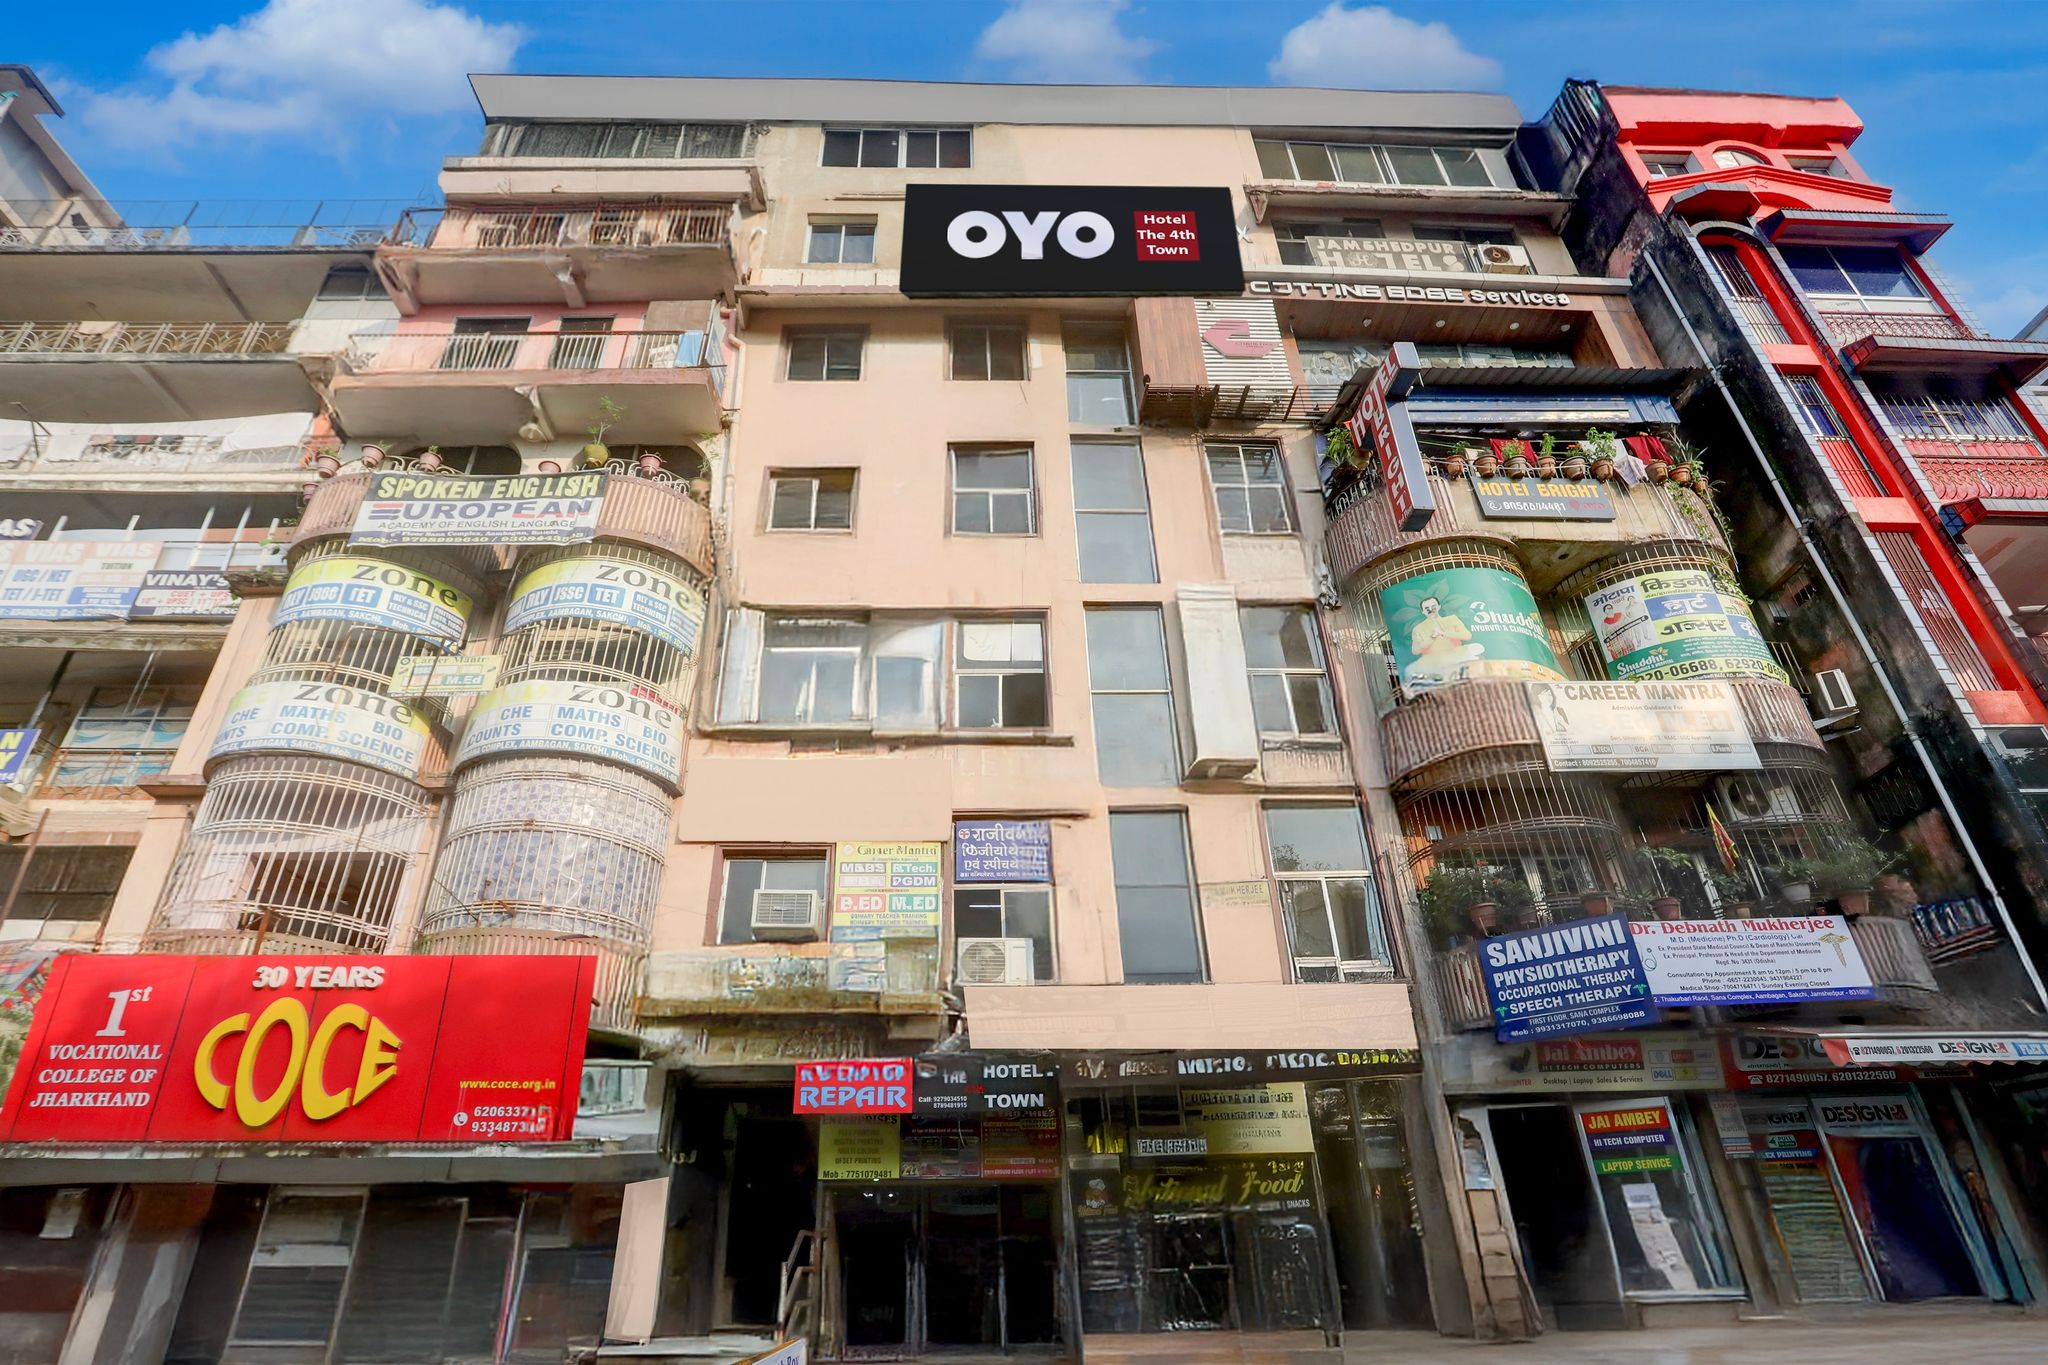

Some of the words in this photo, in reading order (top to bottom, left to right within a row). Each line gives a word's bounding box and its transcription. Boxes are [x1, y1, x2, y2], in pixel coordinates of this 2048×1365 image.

[1144, 214, 1187, 225] Hotel
[947, 210, 1115, 260] OYO
[1138, 230, 1167, 240] The
[1169, 229, 1196, 240] 4th
[1147, 245, 1189, 255] Town
[1470, 289, 1571, 306] Services
[1352, 360, 1398, 448] HOTEL
[377, 476, 486, 499] SPOKEN
[491, 474, 601, 499] ENGLISH
[1536, 483, 1600, 498] BRIGHT
[368, 499, 594, 521] EUROPEAN
[378, 521, 436, 530] ACADEMY
[438, 521, 455, 529] OF
[457, 521, 509, 529] ENGLISH
[146, 573, 230, 586] VINAY's
[352, 564, 459, 607] zone
[596, 564, 691, 610] zone
[526, 590, 549, 609] RLY
[554, 586, 585, 602] JSSC
[594, 586, 620, 604] TET
[348, 610, 384, 624] SAKCHI,
[548, 608, 594, 618] AAMBAGAN,
[596, 610, 628, 625] SAKCHI,
[446, 675, 483, 685] M.Ed
[1564, 683, 1641, 701] CAREER
[1643, 683, 1726, 701] MANTRA
[294, 683, 413, 725] zone
[568, 683, 673, 730] zone
[231, 707, 261, 724] CHE
[279, 704, 347, 723] MATHS
[372, 720, 403, 741] BIO
[500, 705, 534, 721] CHE
[557, 706, 622, 727] MATHS
[643, 725, 667, 745] BIO
[271, 721, 329, 738] COMP.
[336, 731, 415, 765] SCIENCE
[520, 739, 570, 749] AAMBAGAN,
[574, 741, 609, 754] SAKCHI,
[550, 723, 608, 742] COMP.
[614, 733, 677, 768] SCIENCE
[840, 896, 883, 910] B.ED
[892, 896, 936, 910] M.ED
[1628, 921, 1656, 935] Dr.
[1661, 919, 1738, 934] Debnath
[1742, 917, 1835, 934] Mukherjee
[1486, 919, 1627, 968] SANJIVINI
[1688, 935, 1726, 943] (Medicine)
[1745, 933, 1790, 942] (Cardiology)
[1760, 949, 1789, 957] Department
[1492, 949, 1631, 988] PHYSIOTHERAPY
[1714, 970, 1752, 978] Appointment
[252, 966, 289, 989] 30
[294, 966, 385, 989] YEARS
[1498, 977, 1582, 1002] OCCUPATIONAL
[1582, 967, 1636, 988] THERAPY
[1784, 981, 1808, 989] Evening
[1509, 996, 1563, 1015] SPEECH
[1565, 983, 1633, 1006] THERAPY
[1727, 993, 1755, 1001] Complex,
[1810, 990, 1845, 998] Jamshedpur
[96, 986, 154, 1038] 1st
[1529, 1017, 1547, 1026] FIRST
[1570, 1011, 1589, 1020] SANA
[1589, 1005, 1621, 1017] COMPLEX
[1591, 1011, 1646, 1025] 9386698088
[49, 1043, 163, 1061] VOCATIONAL
[194, 996, 404, 1127] COCE
[1583, 1062, 1641, 1070] COMPUTERS
[38, 1068, 127, 1084] COLLEGE
[129, 1068, 158, 1084] OF
[983, 1064, 1044, 1078] HOTEL
[1653, 1069, 1673, 1080] DELL
[1832, 1069, 1896, 1082] 6201322560
[459, 1078, 556, 1092] www.coce.org.in
[1543, 1076, 1568, 1085] Desktop
[1573, 1076, 1593, 1085] Laptop
[1597, 1075, 1611, 1083] Sales
[1619, 1075, 1644, 1083] Services
[30, 1091, 151, 1108] JHARKHAND
[800, 1086, 907, 1108] REPAIR
[984, 1094, 1045, 1108] TOWN
[1589, 1115, 1610, 1130] JAI
[1614, 1110, 1662, 1127] AMBEY
[1594, 1138, 1602, 1147] HI
[1603, 1137, 1623, 1146] TECH
[1624, 1134, 1666, 1145] COMPUTER
[1602, 1160, 1634, 1172] LAPTOP
[1636, 1157, 1673, 1170] SERVICE
[823, 1170, 839, 1178] Mob
[1286, 1199, 1310, 1208] SNACKS
